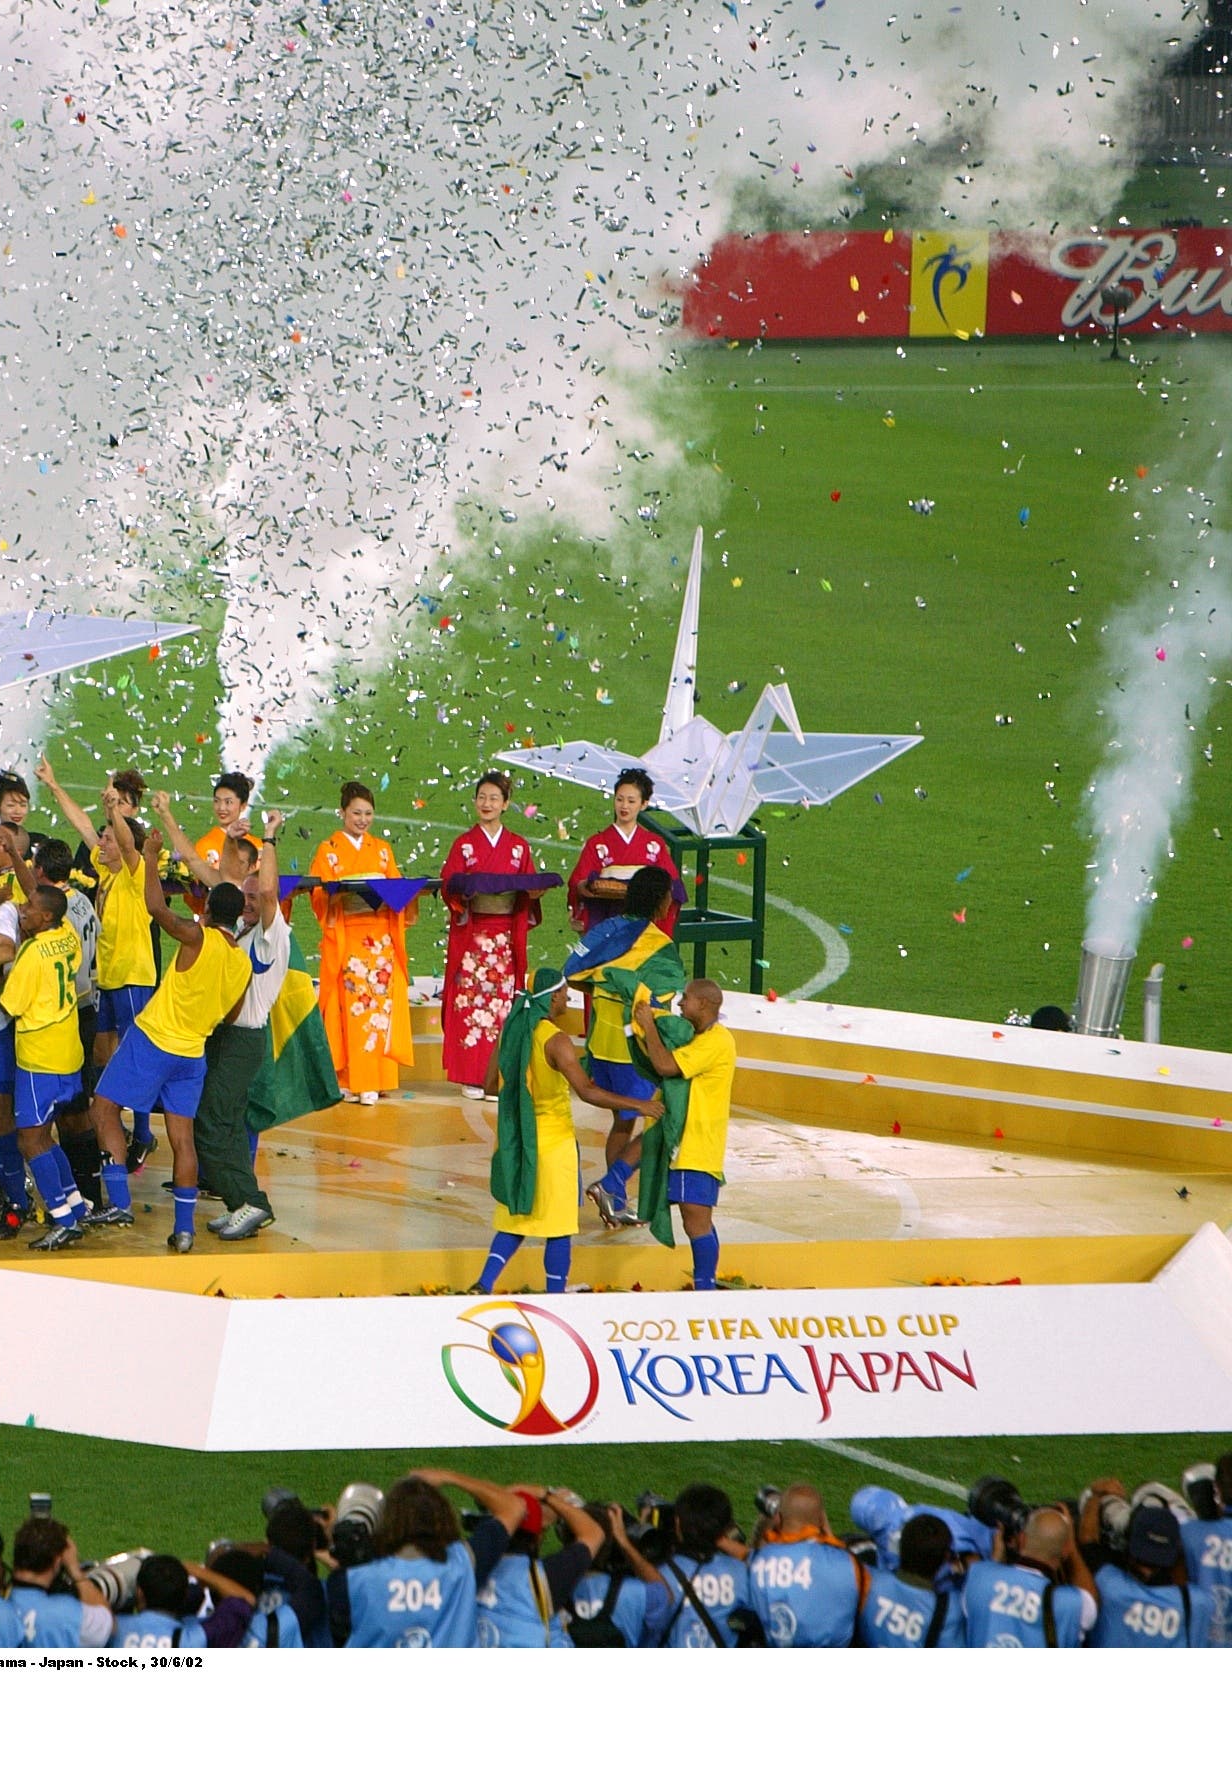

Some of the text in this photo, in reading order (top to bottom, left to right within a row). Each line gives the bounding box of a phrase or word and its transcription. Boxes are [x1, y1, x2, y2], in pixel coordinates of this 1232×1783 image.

[1050, 232, 1232, 329] Bu
[603, 1313, 960, 1342] 2002 FIFA WORLD CUP
[608, 1344, 978, 1424] KOREA JAPAN
[752, 1556, 813, 1590] 1184
[388, 1578, 442, 1612] 204
[875, 1595, 924, 1643] 756
[1123, 1601, 1181, 1639] 490
